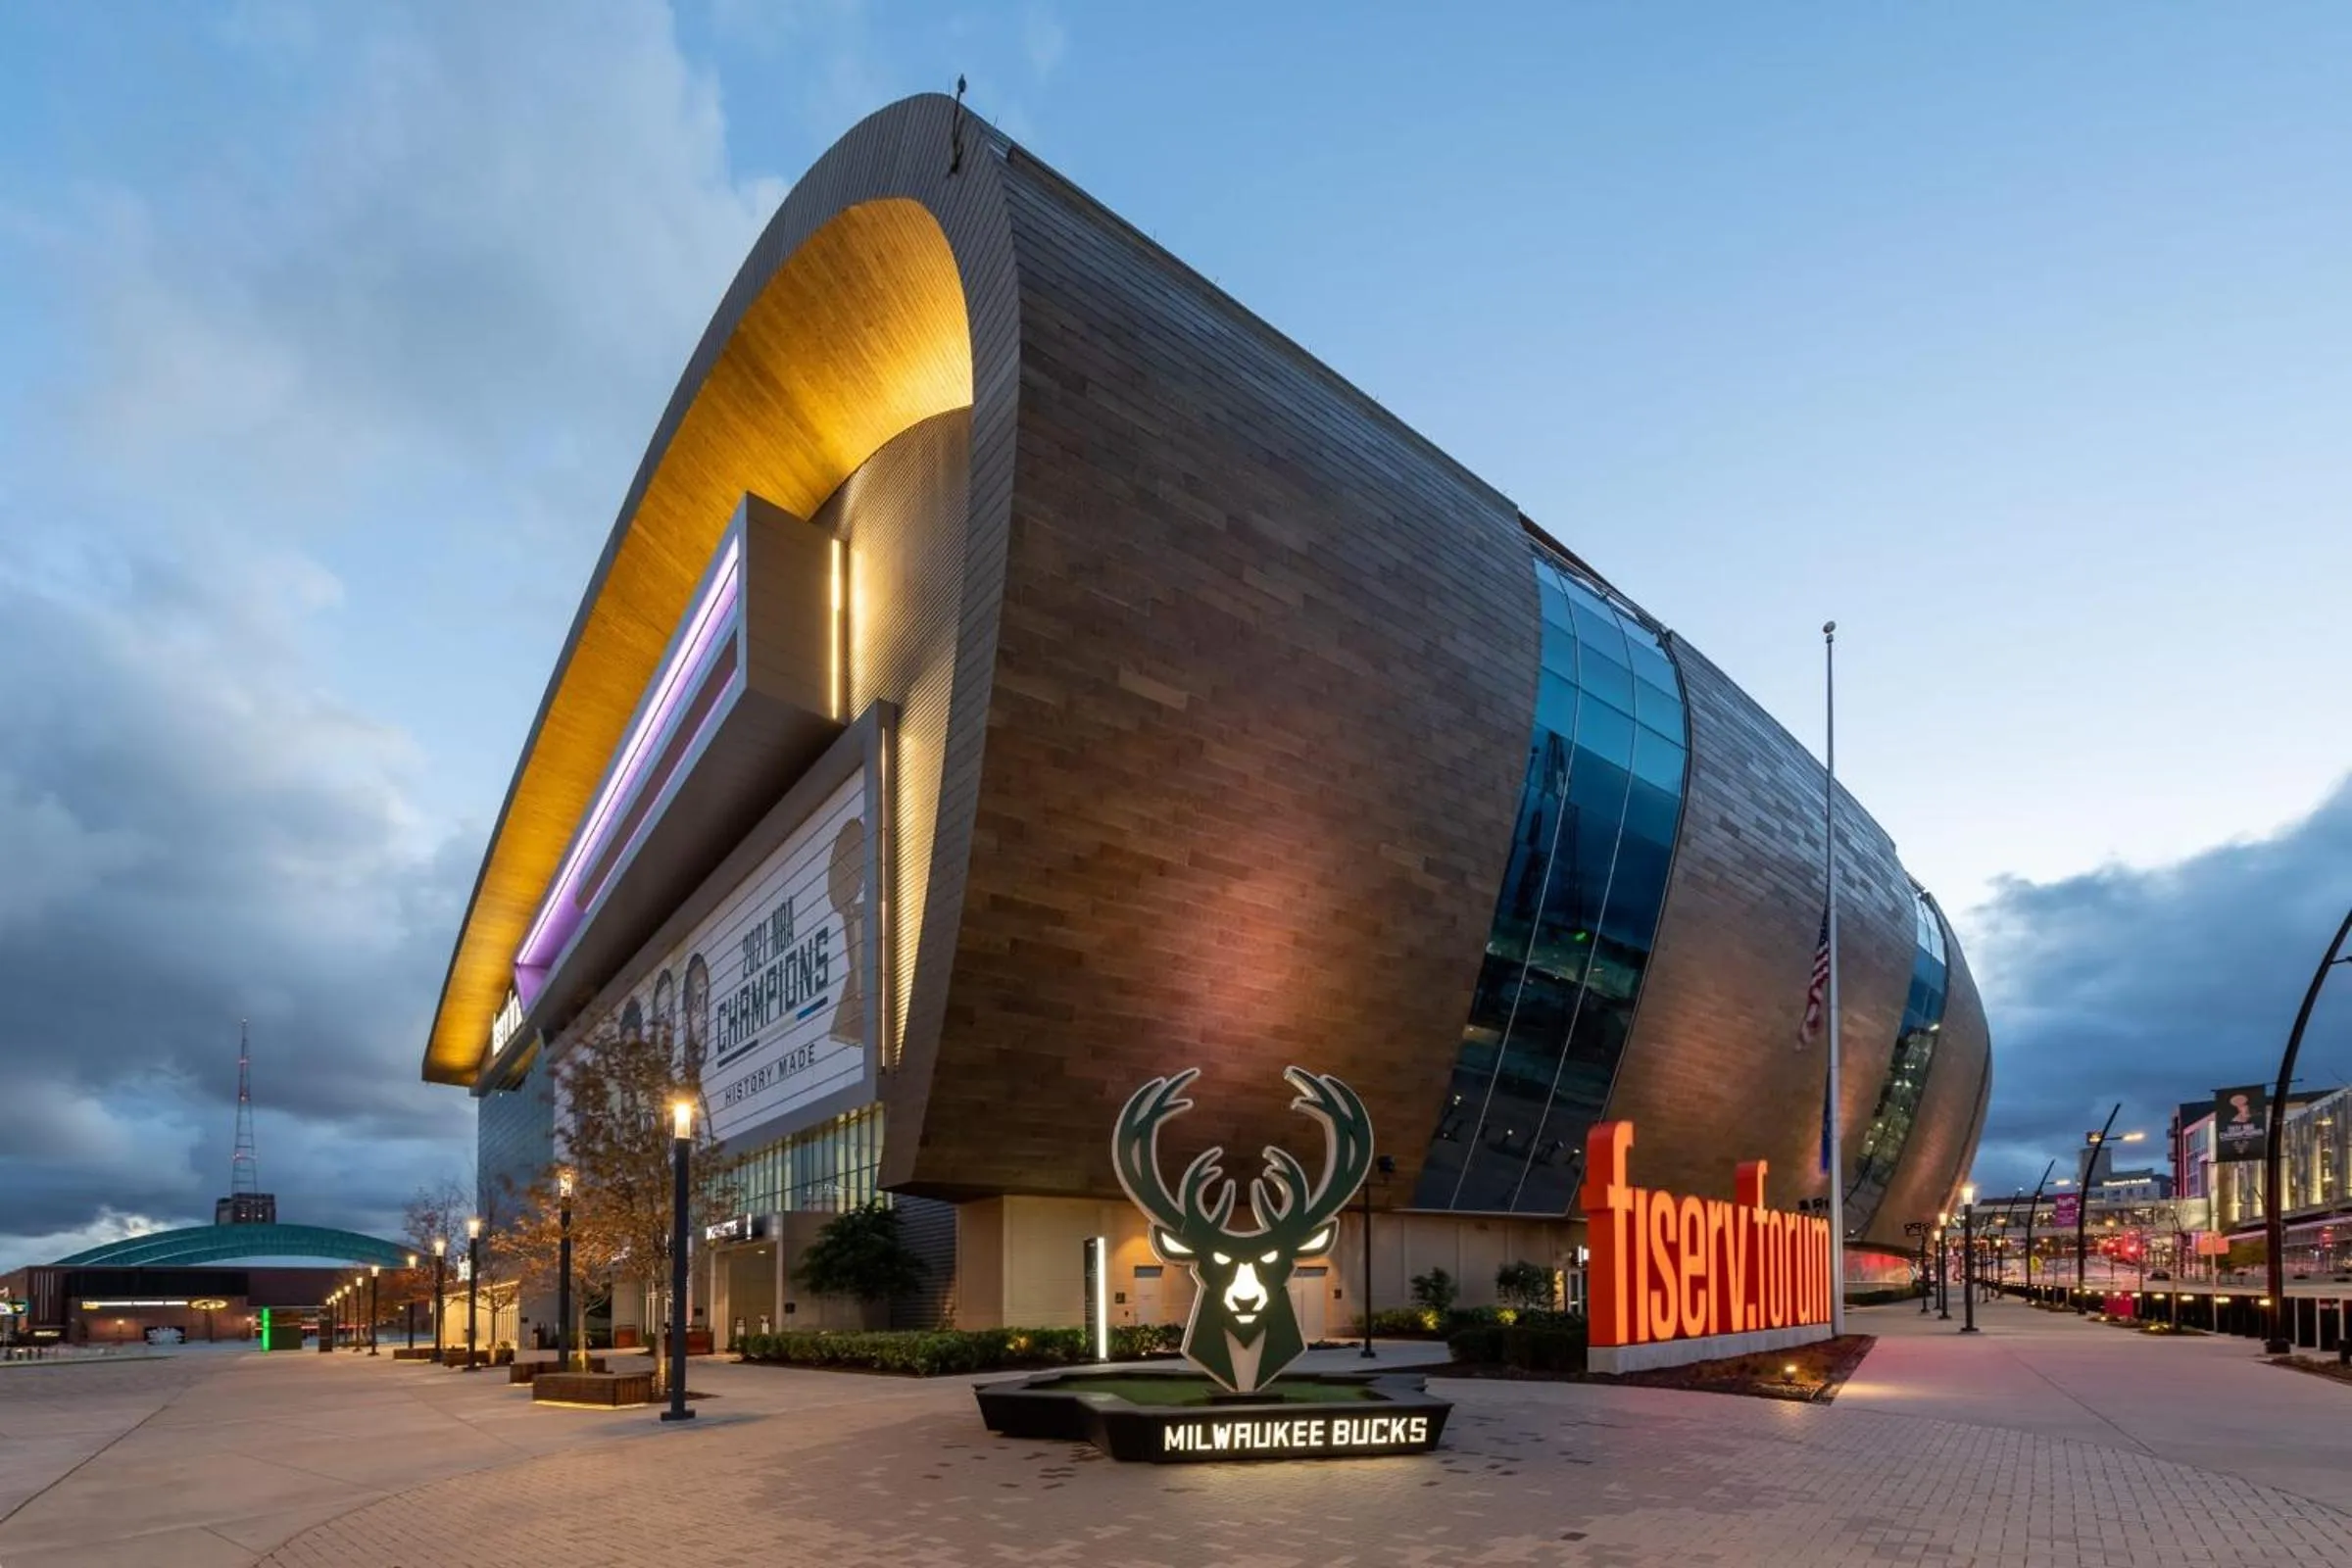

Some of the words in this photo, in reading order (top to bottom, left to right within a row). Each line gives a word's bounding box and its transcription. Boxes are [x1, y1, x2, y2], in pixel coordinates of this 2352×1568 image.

[743, 920, 767, 980] 2021
[772, 896, 794, 957] NBA
[717, 926, 829, 1054] CHAMPIONS
[725, 1066, 773, 1105] HISTORY
[779, 1044, 814, 1080] MADE
[1163, 1420, 1325, 1451] MILWAUKEE
[1332, 1417, 1428, 1446] BUCKS
